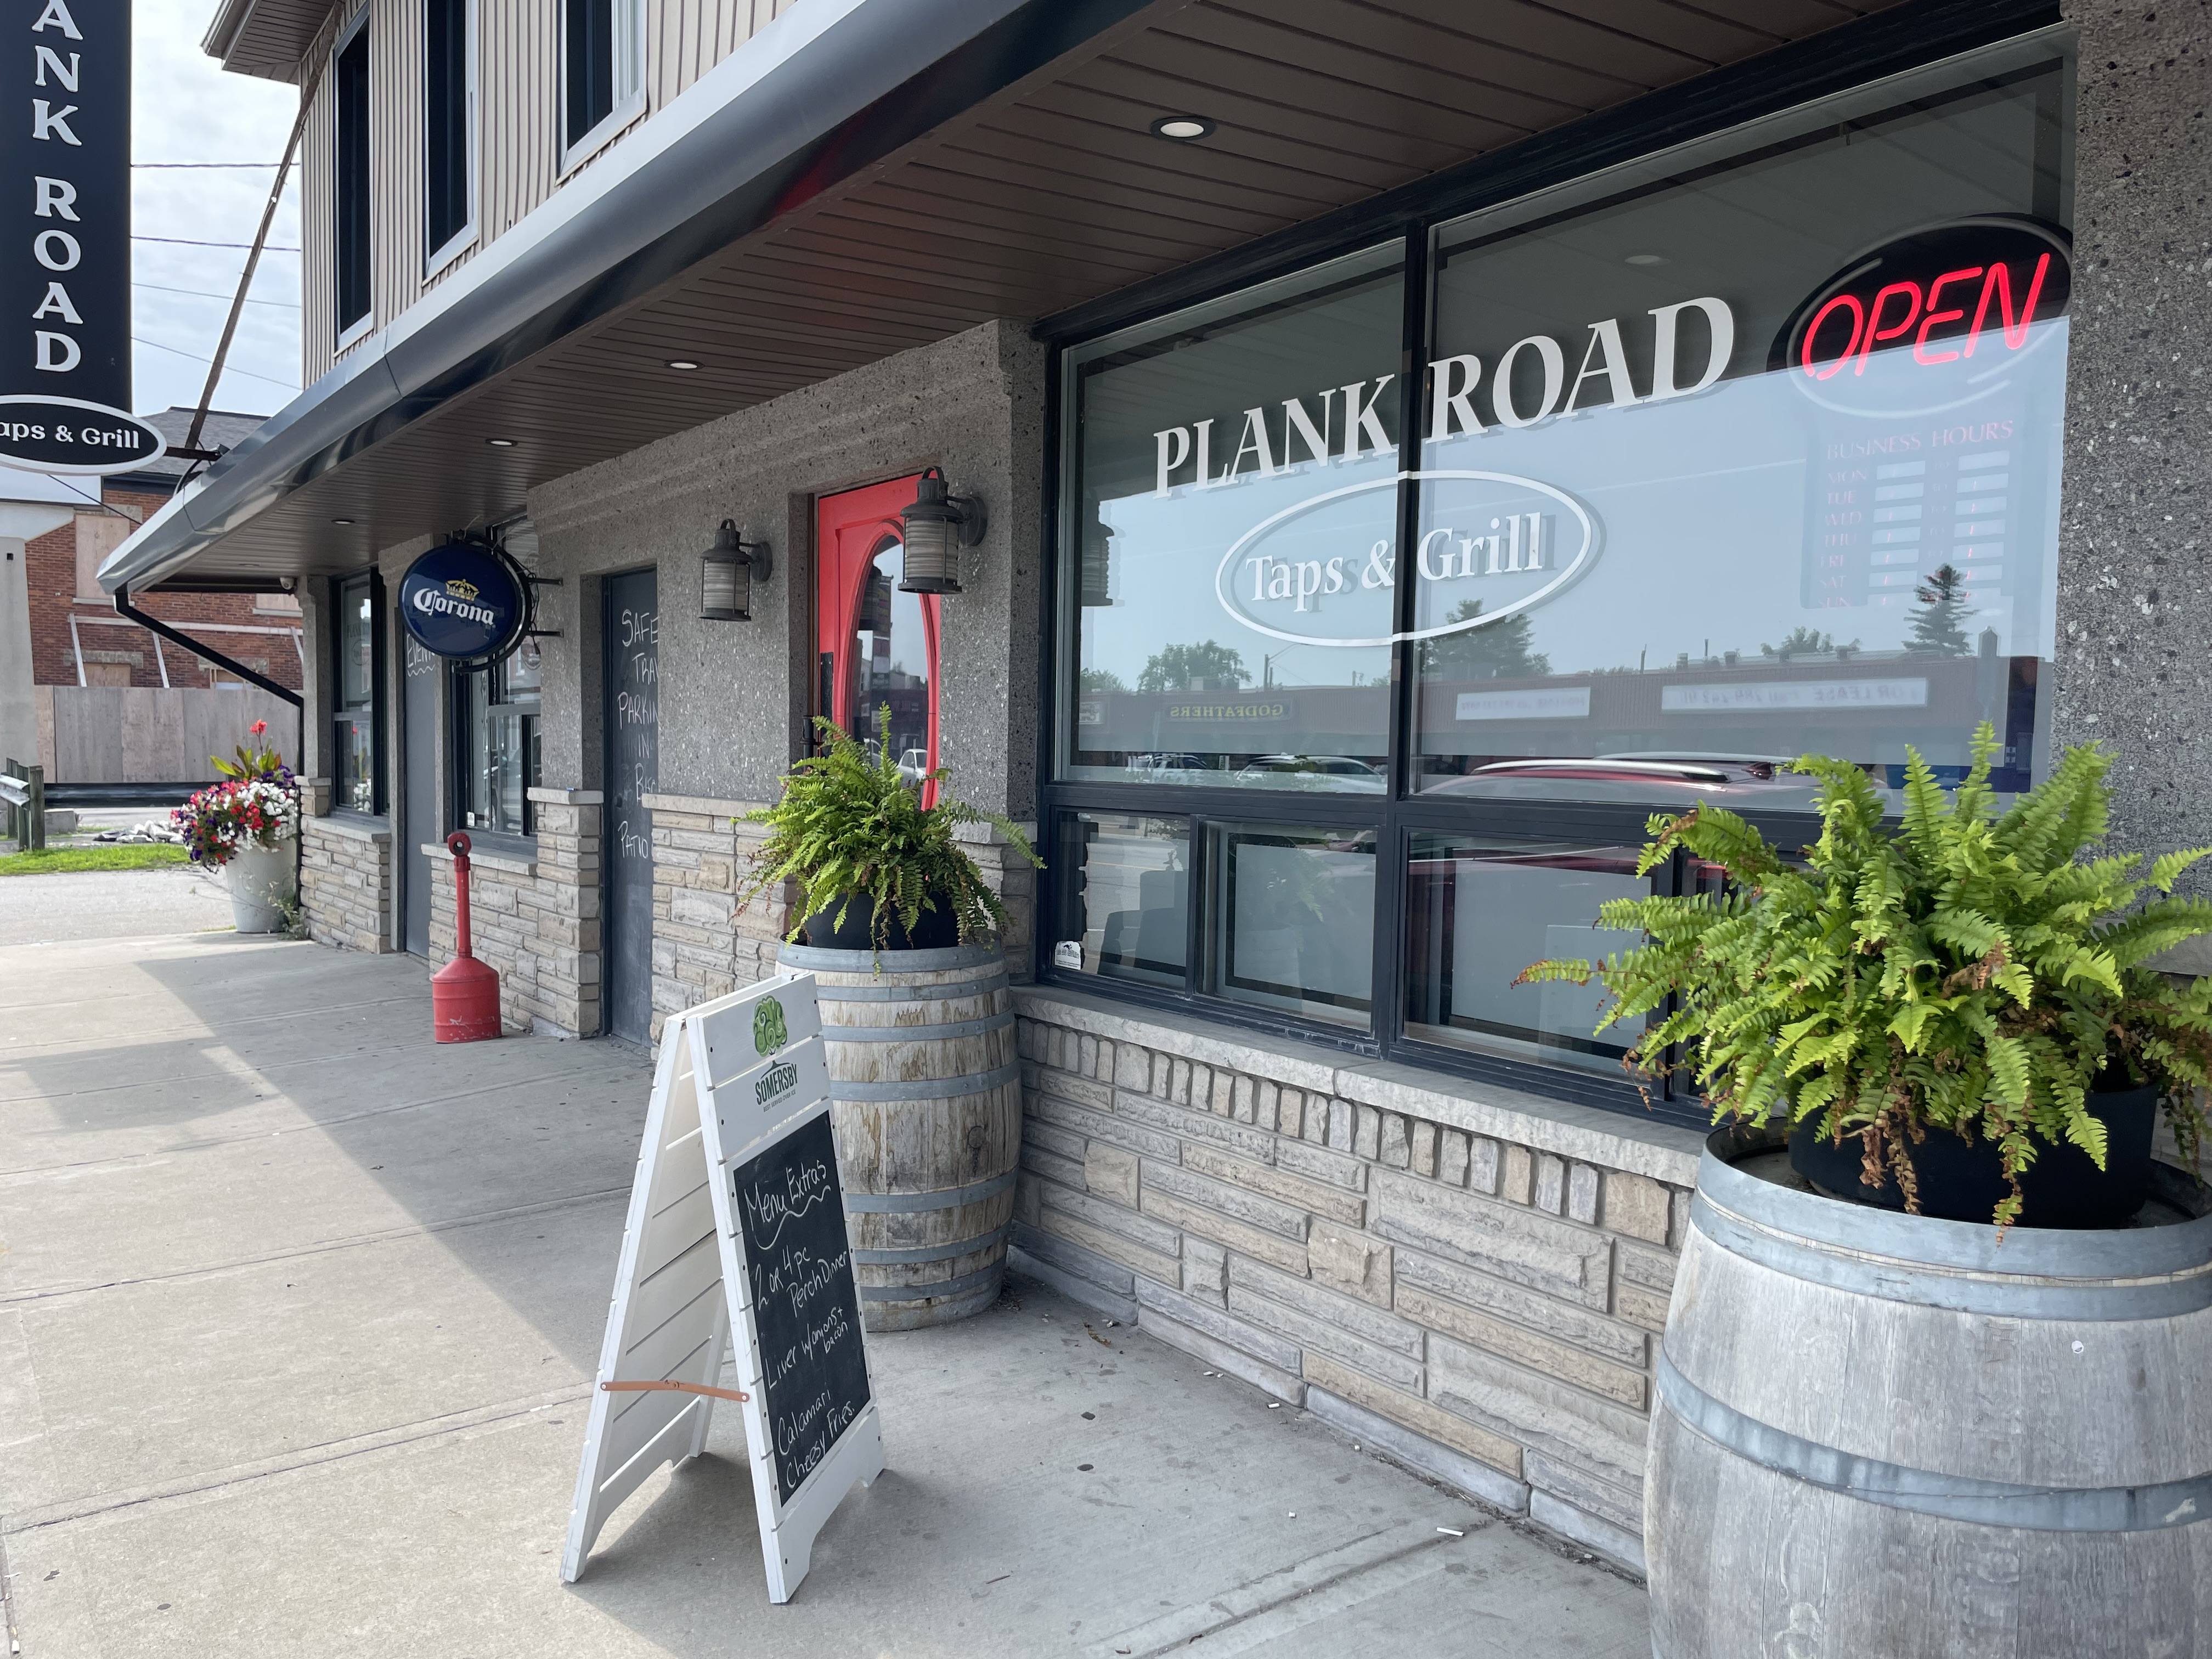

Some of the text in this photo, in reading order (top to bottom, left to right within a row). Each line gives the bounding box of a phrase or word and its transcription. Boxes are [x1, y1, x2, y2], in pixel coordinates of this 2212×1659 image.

[32, 176, 83, 373] ROAD
[1802, 252, 2050, 381] OPEN
[1153, 296, 1734, 499] PLANK ROAD
[55, 425, 74, 443] &
[82, 427, 139, 449] Grill
[1826, 419, 2015, 460] BUSINESS HOURS
[1826, 490, 1857, 505] TUE
[1245, 511, 1543, 612] Taps & Grill
[414, 588, 494, 625] Corona
[638, 733, 650, 758] IN
[618, 820, 649, 859] PATIO
[755, 1063, 798, 1105] SOMERSBY
[771, 1097, 783, 1108] SERVED
[744, 1182, 788, 1232] Menu
[755, 1263, 769, 1311] 2
[782, 1244, 793, 1275] 4
[786, 1250, 847, 1318] Perch Dinner
[823, 1321, 849, 1354] bacon
[765, 1344, 796, 1390] Liver
[778, 1384, 831, 1455] Calamari
[786, 1430, 826, 1489] Cheesy
